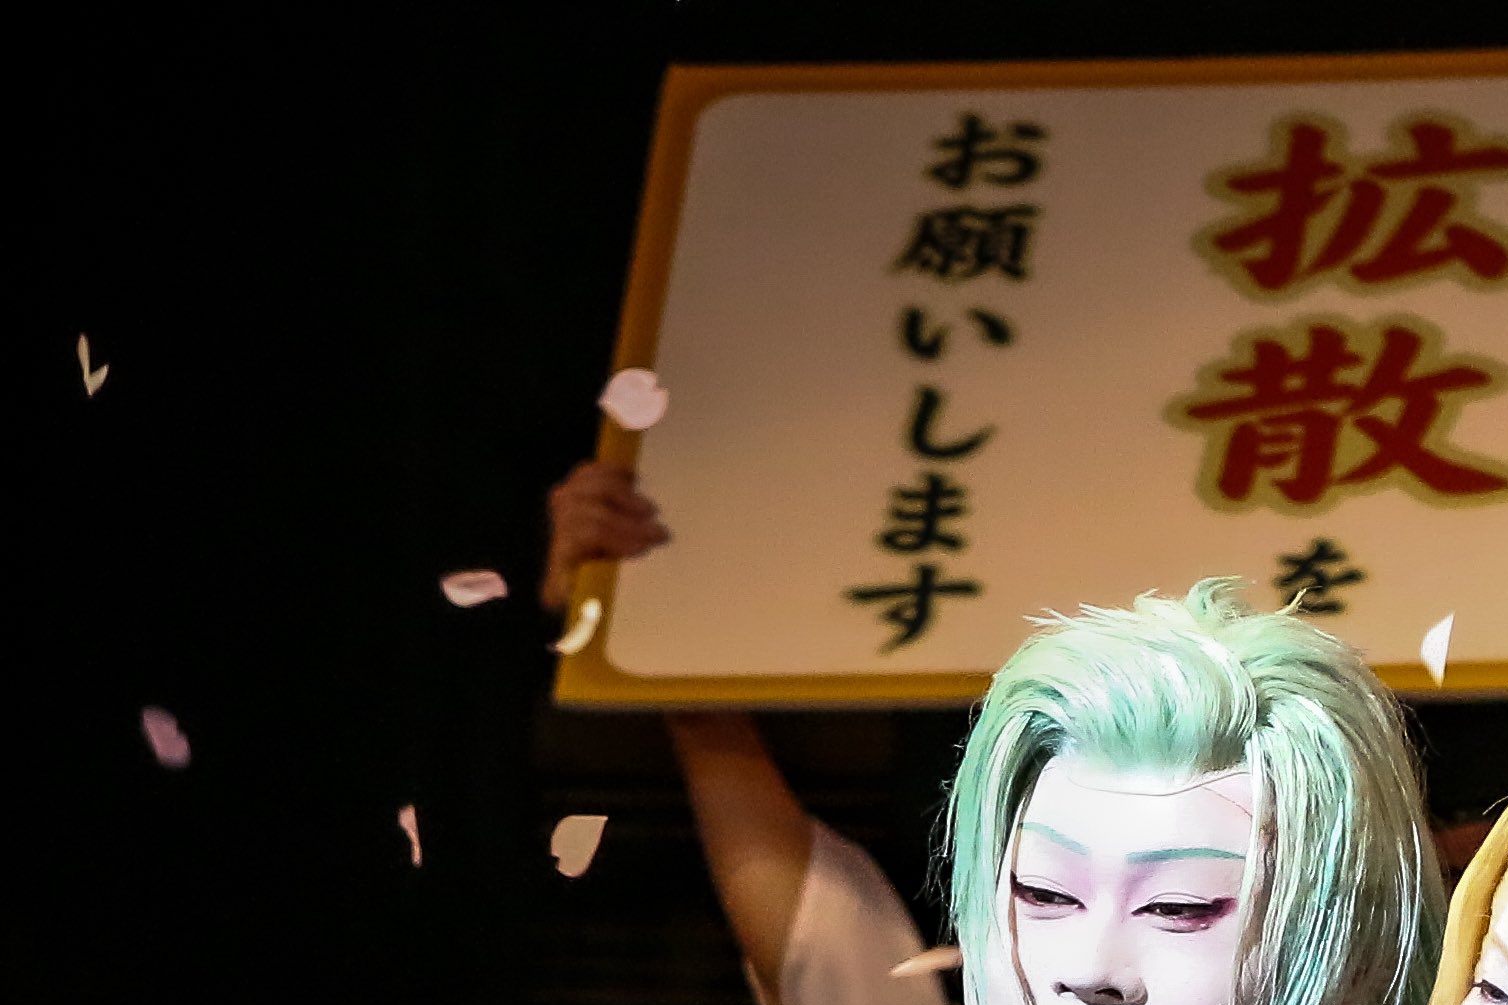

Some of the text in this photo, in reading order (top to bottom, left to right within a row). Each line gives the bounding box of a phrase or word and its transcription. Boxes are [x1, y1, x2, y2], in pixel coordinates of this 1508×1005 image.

[842, 112, 1050, 653] お願いします
